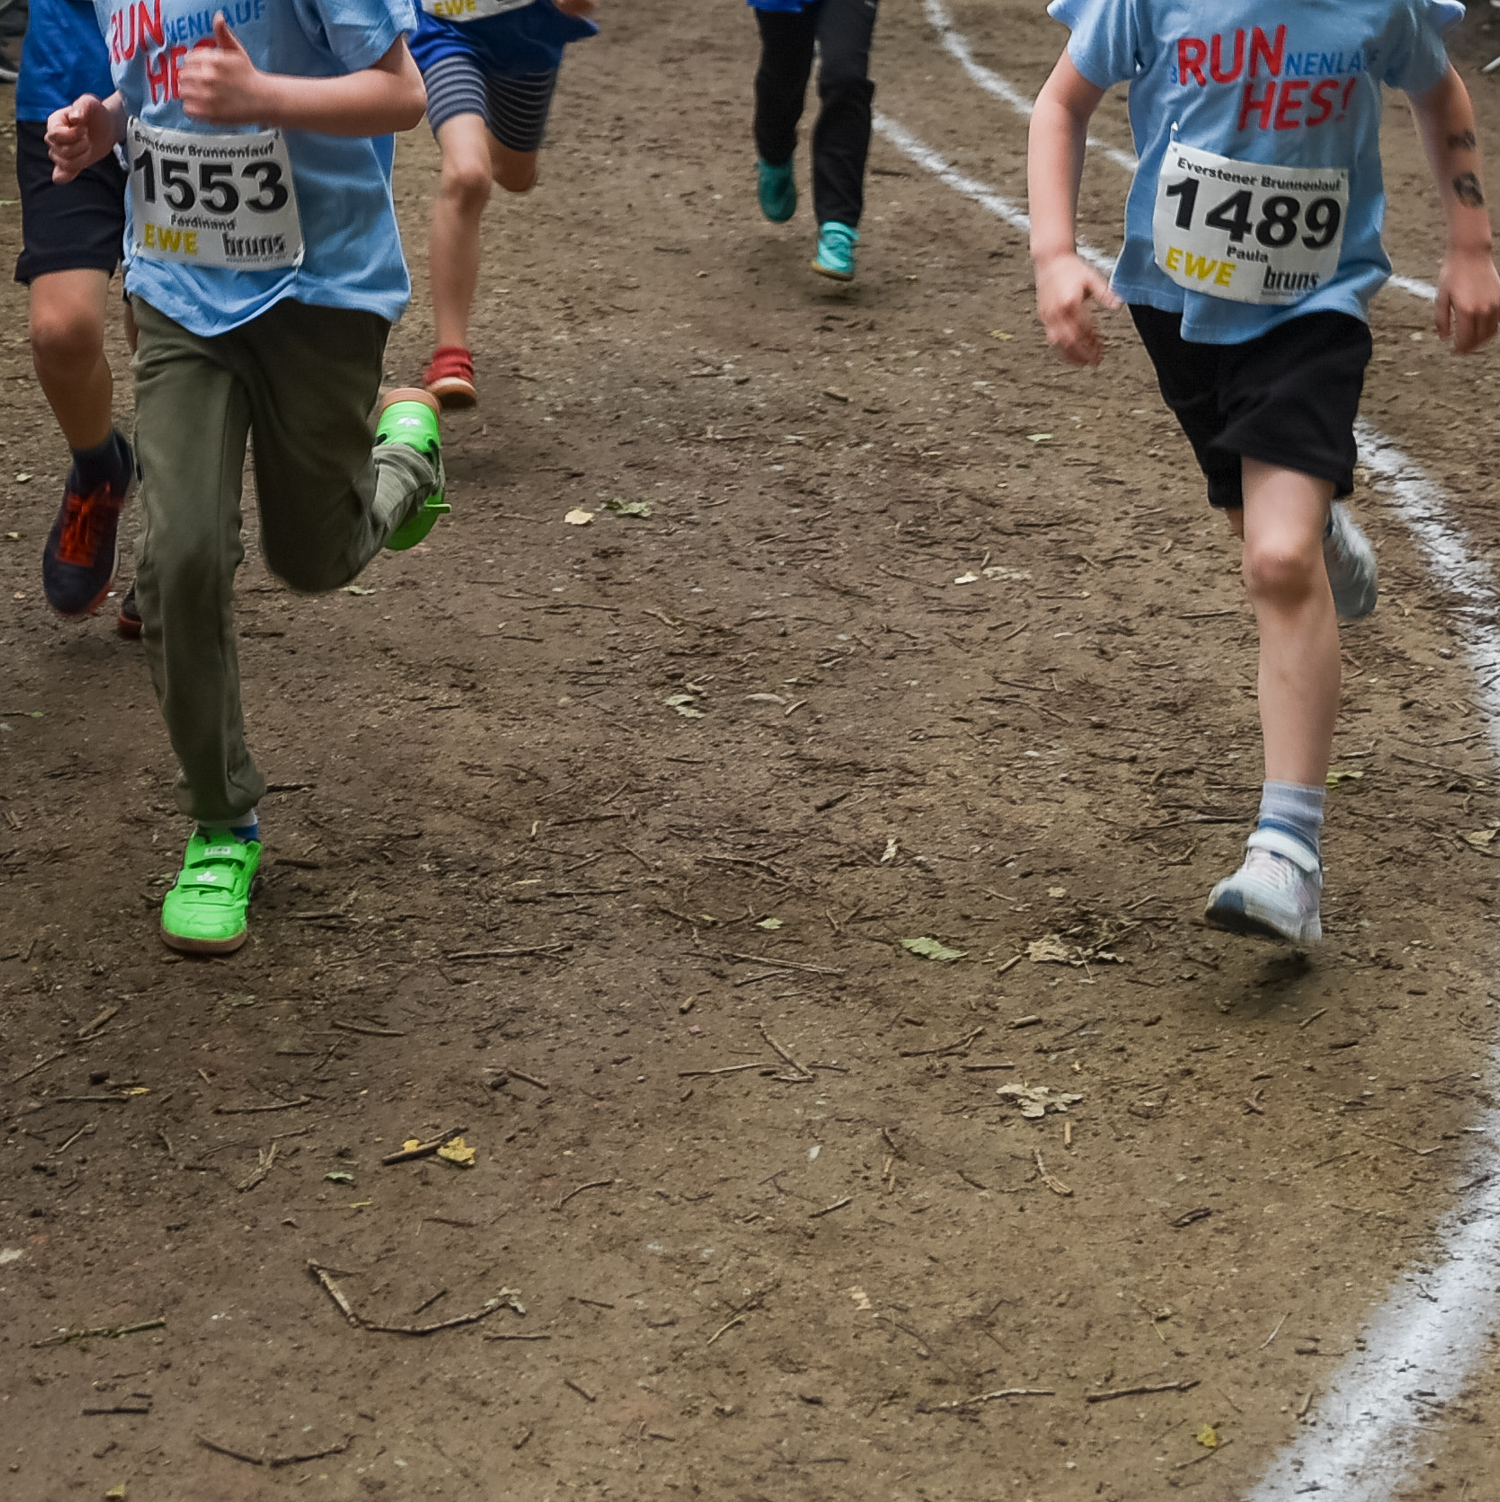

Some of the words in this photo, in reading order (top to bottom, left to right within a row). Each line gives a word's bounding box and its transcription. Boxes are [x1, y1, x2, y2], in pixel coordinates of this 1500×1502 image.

[1237, 76, 1357, 132] HES!
[134, 149, 289, 215] 1553
[1176, 156, 1258, 186] Everstener
[1261, 174, 1341, 193] Brunnenlauf
[171, 214, 237, 231] Ferdinand
[1165, 176, 1341, 250] 1489
[144, 223, 198, 255] EWE
[222, 232, 286, 256] bruns
[1226, 245, 1269, 263] Paula
[1165, 245, 1237, 287] EWE
[1263, 265, 1320, 290] bruns
